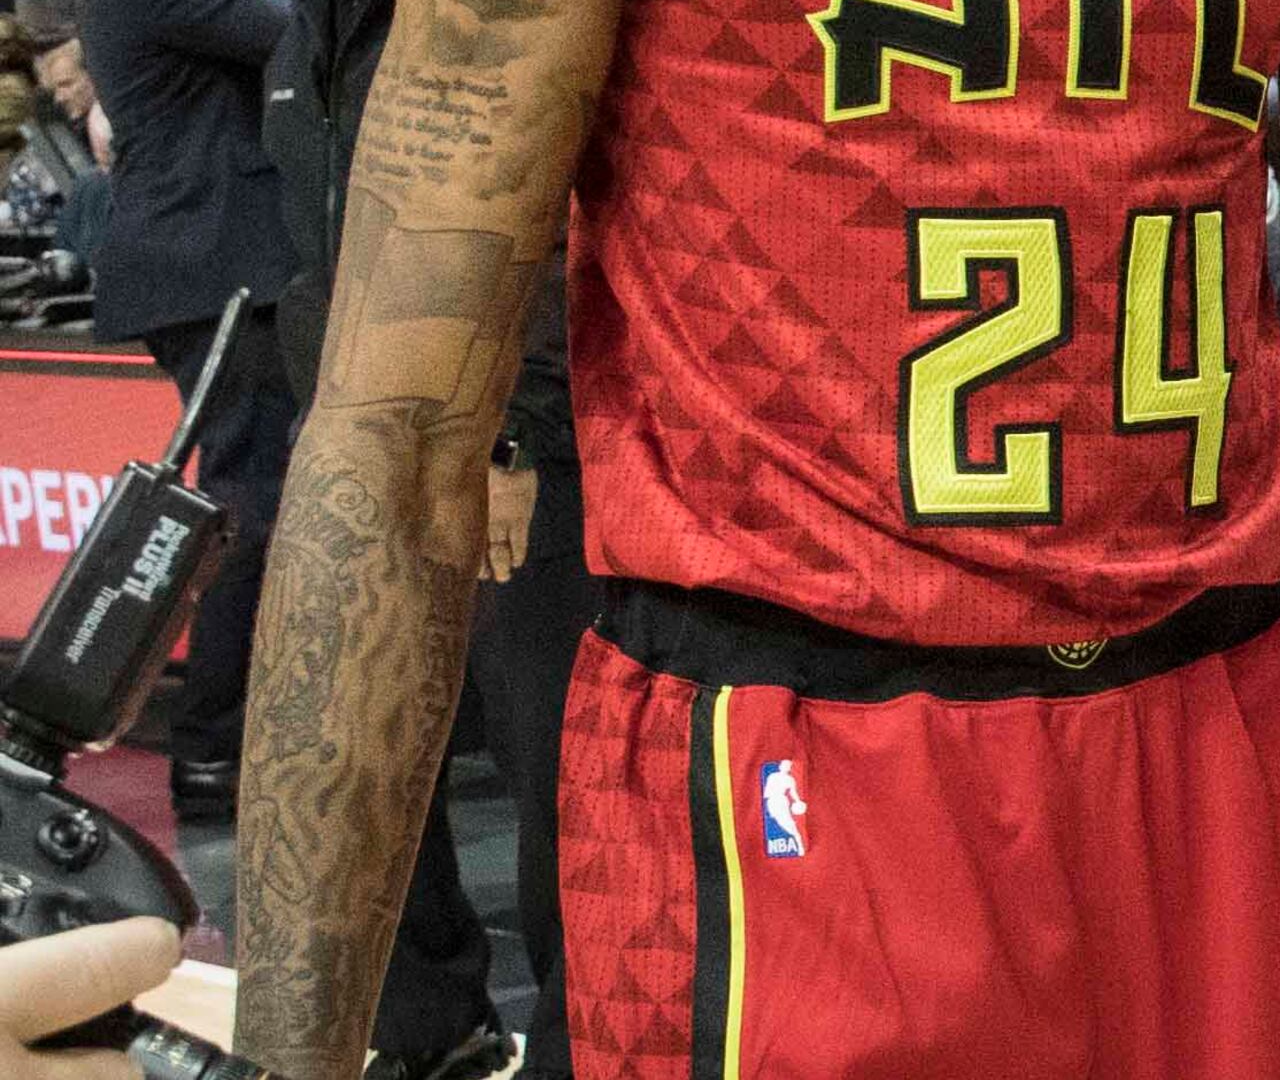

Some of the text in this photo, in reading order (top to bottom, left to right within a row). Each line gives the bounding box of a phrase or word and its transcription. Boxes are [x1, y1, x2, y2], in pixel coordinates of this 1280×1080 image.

[900, 204, 1235, 527] 24
[65, 586, 121, 664] Transceiver
[767, 836, 799, 854] NBA
